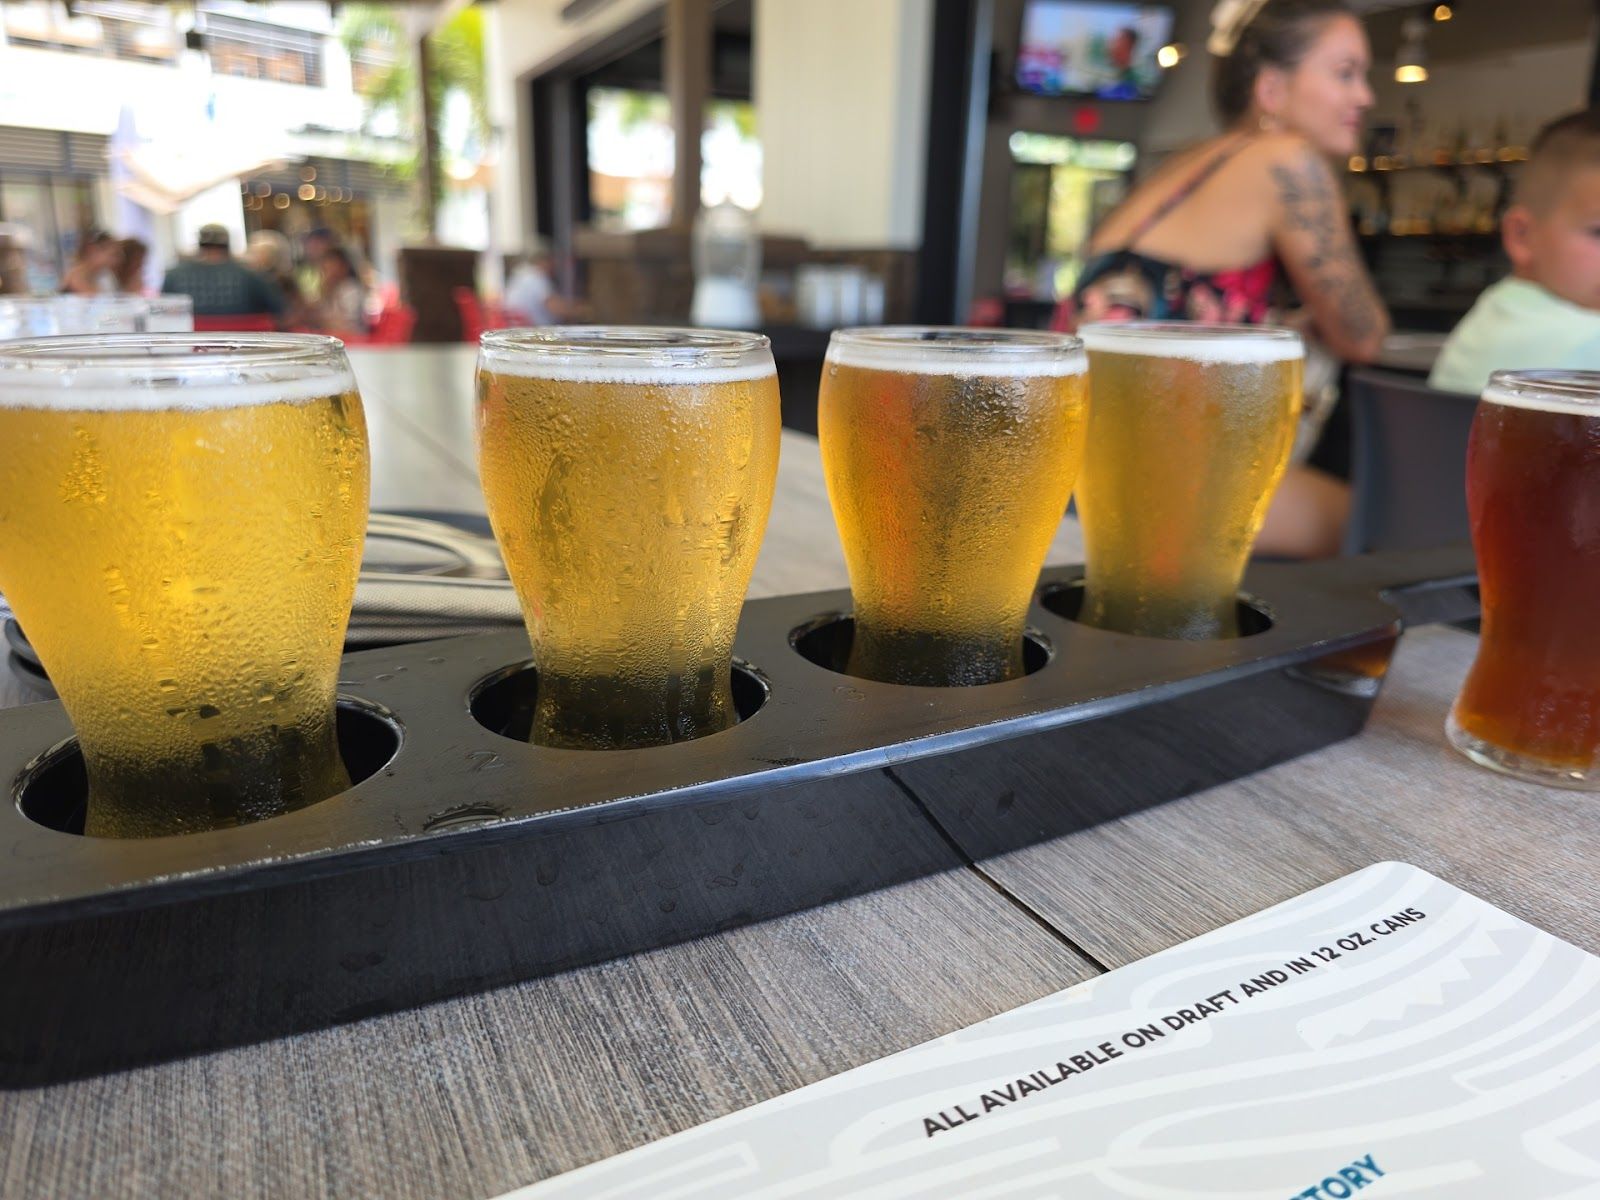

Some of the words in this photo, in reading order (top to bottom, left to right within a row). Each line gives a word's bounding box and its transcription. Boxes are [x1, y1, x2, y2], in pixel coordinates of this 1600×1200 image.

[923, 1105, 980, 1138] ALL
[980, 1041, 1124, 1113] AVAILABLE
[1121, 1023, 1166, 1048] ON
[1161, 989, 1239, 1031] DRAFT
[1239, 969, 1289, 998] AND
[1284, 957, 1317, 975] IN
[1311, 946, 1342, 963] 12
[1336, 932, 1377, 951] OZ.
[1370, 907, 1426, 936] CANS
[1290, 1154, 1385, 1200] TORY
